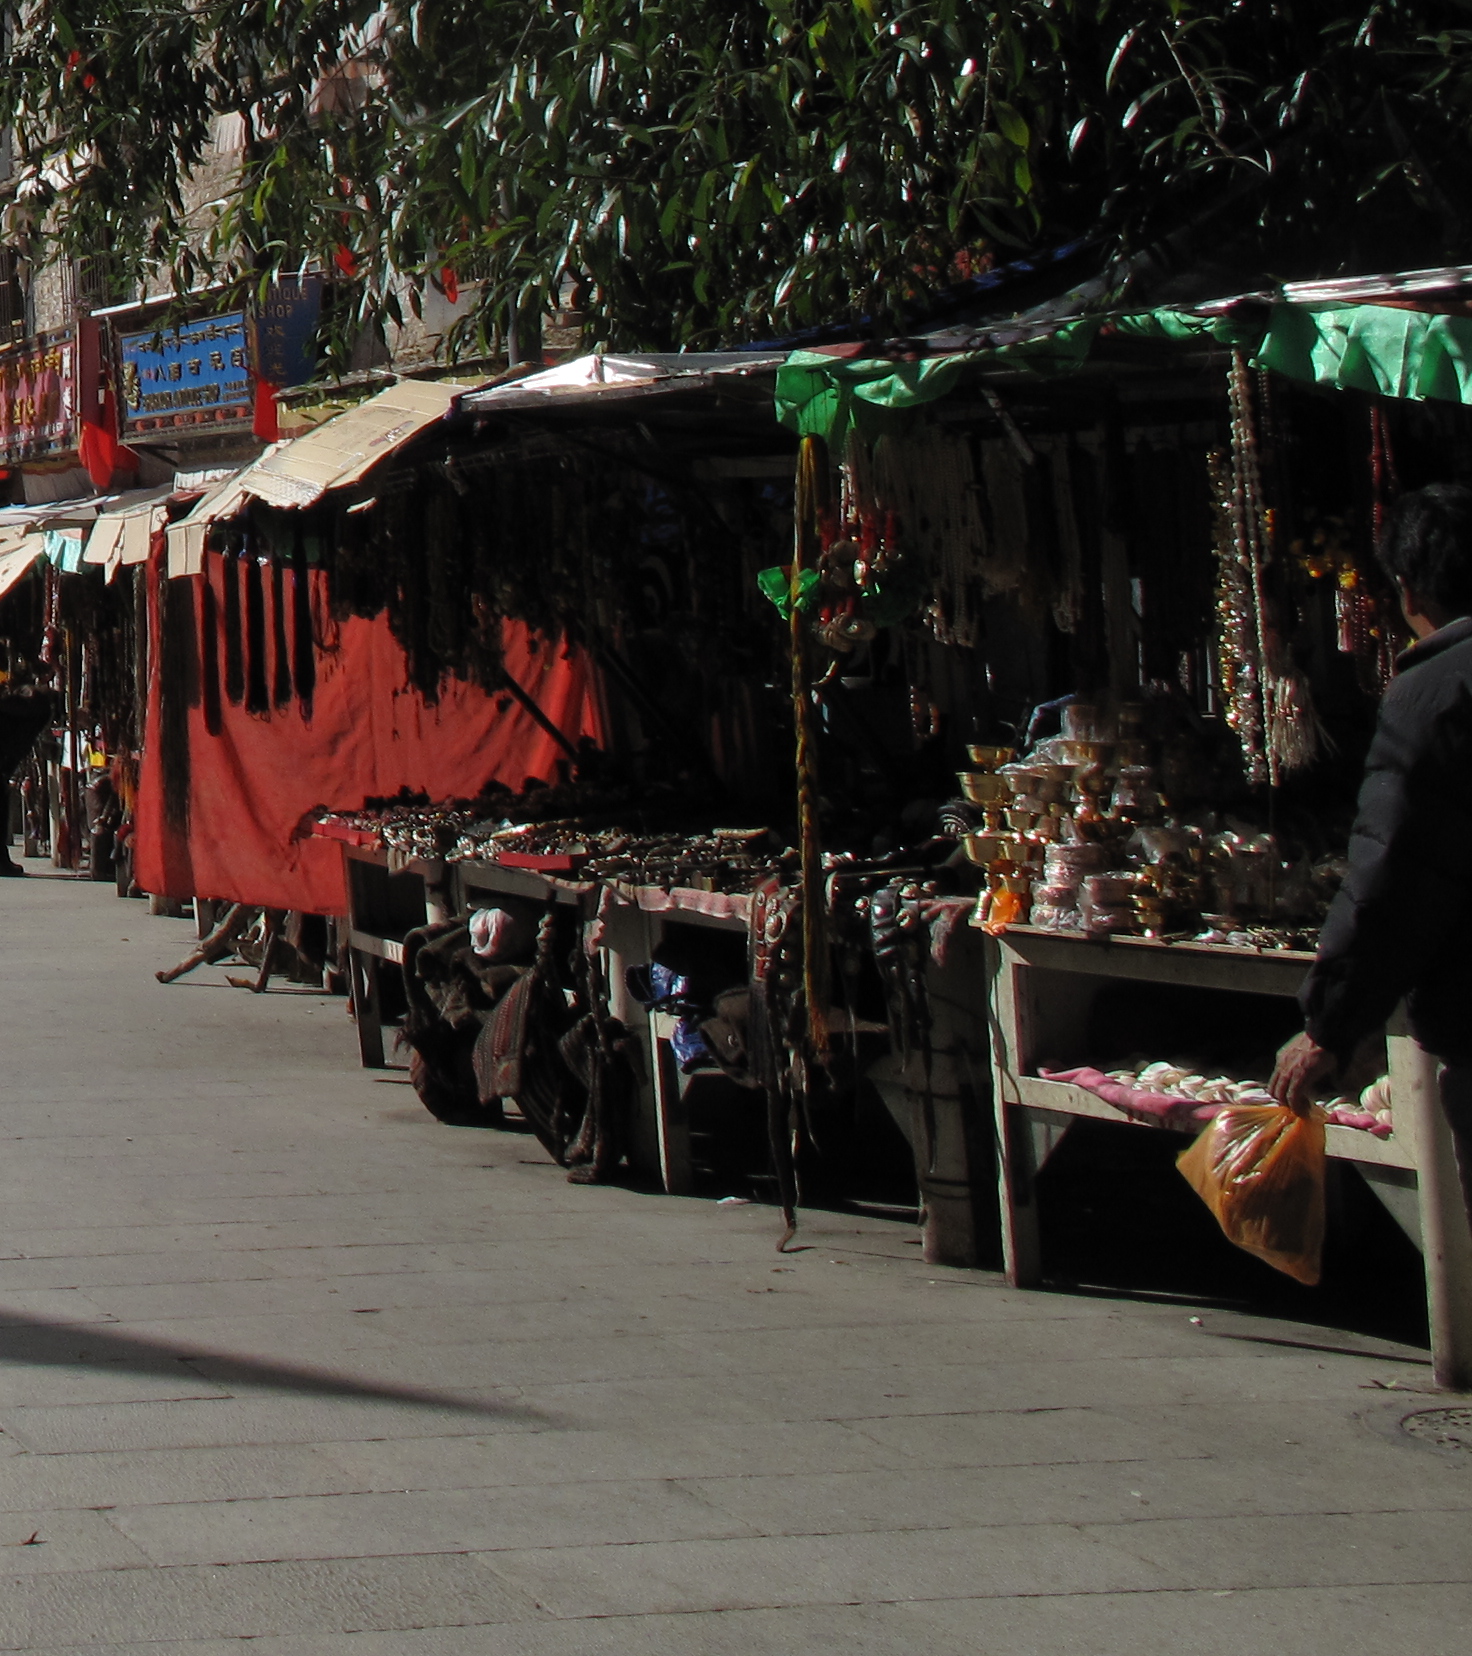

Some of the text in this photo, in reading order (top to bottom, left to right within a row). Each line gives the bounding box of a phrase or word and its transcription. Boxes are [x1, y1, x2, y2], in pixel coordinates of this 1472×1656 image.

[258, 304, 293, 319] SHOP
[265, 325, 288, 387] 欢迎光
